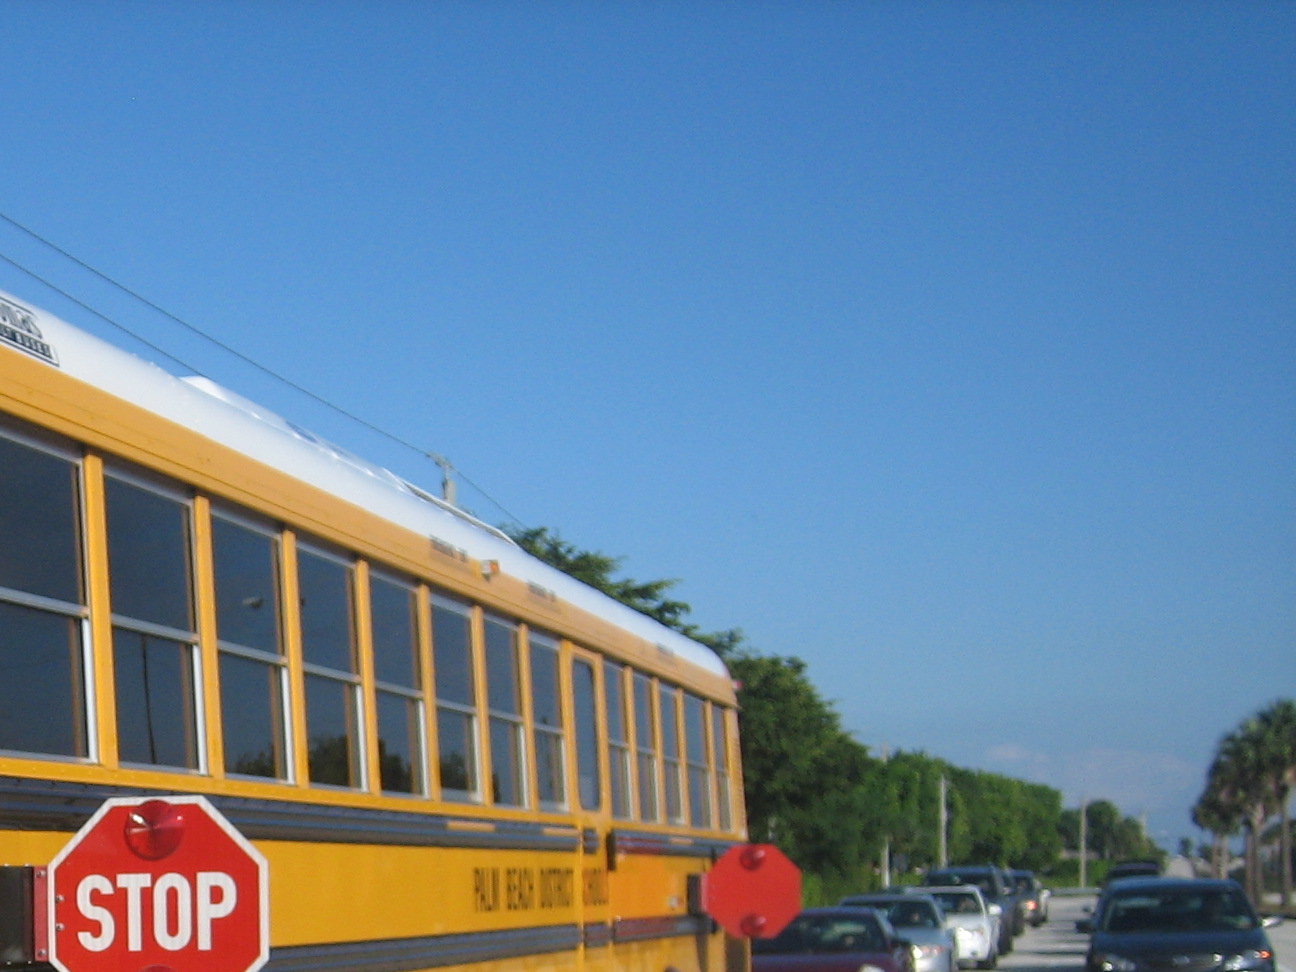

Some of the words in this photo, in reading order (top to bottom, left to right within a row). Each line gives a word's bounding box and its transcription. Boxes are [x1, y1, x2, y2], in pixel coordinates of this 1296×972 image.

[76, 871, 238, 952] STOP
[474, 867, 500, 912] PALM
[506, 867, 534, 911] BEACH
